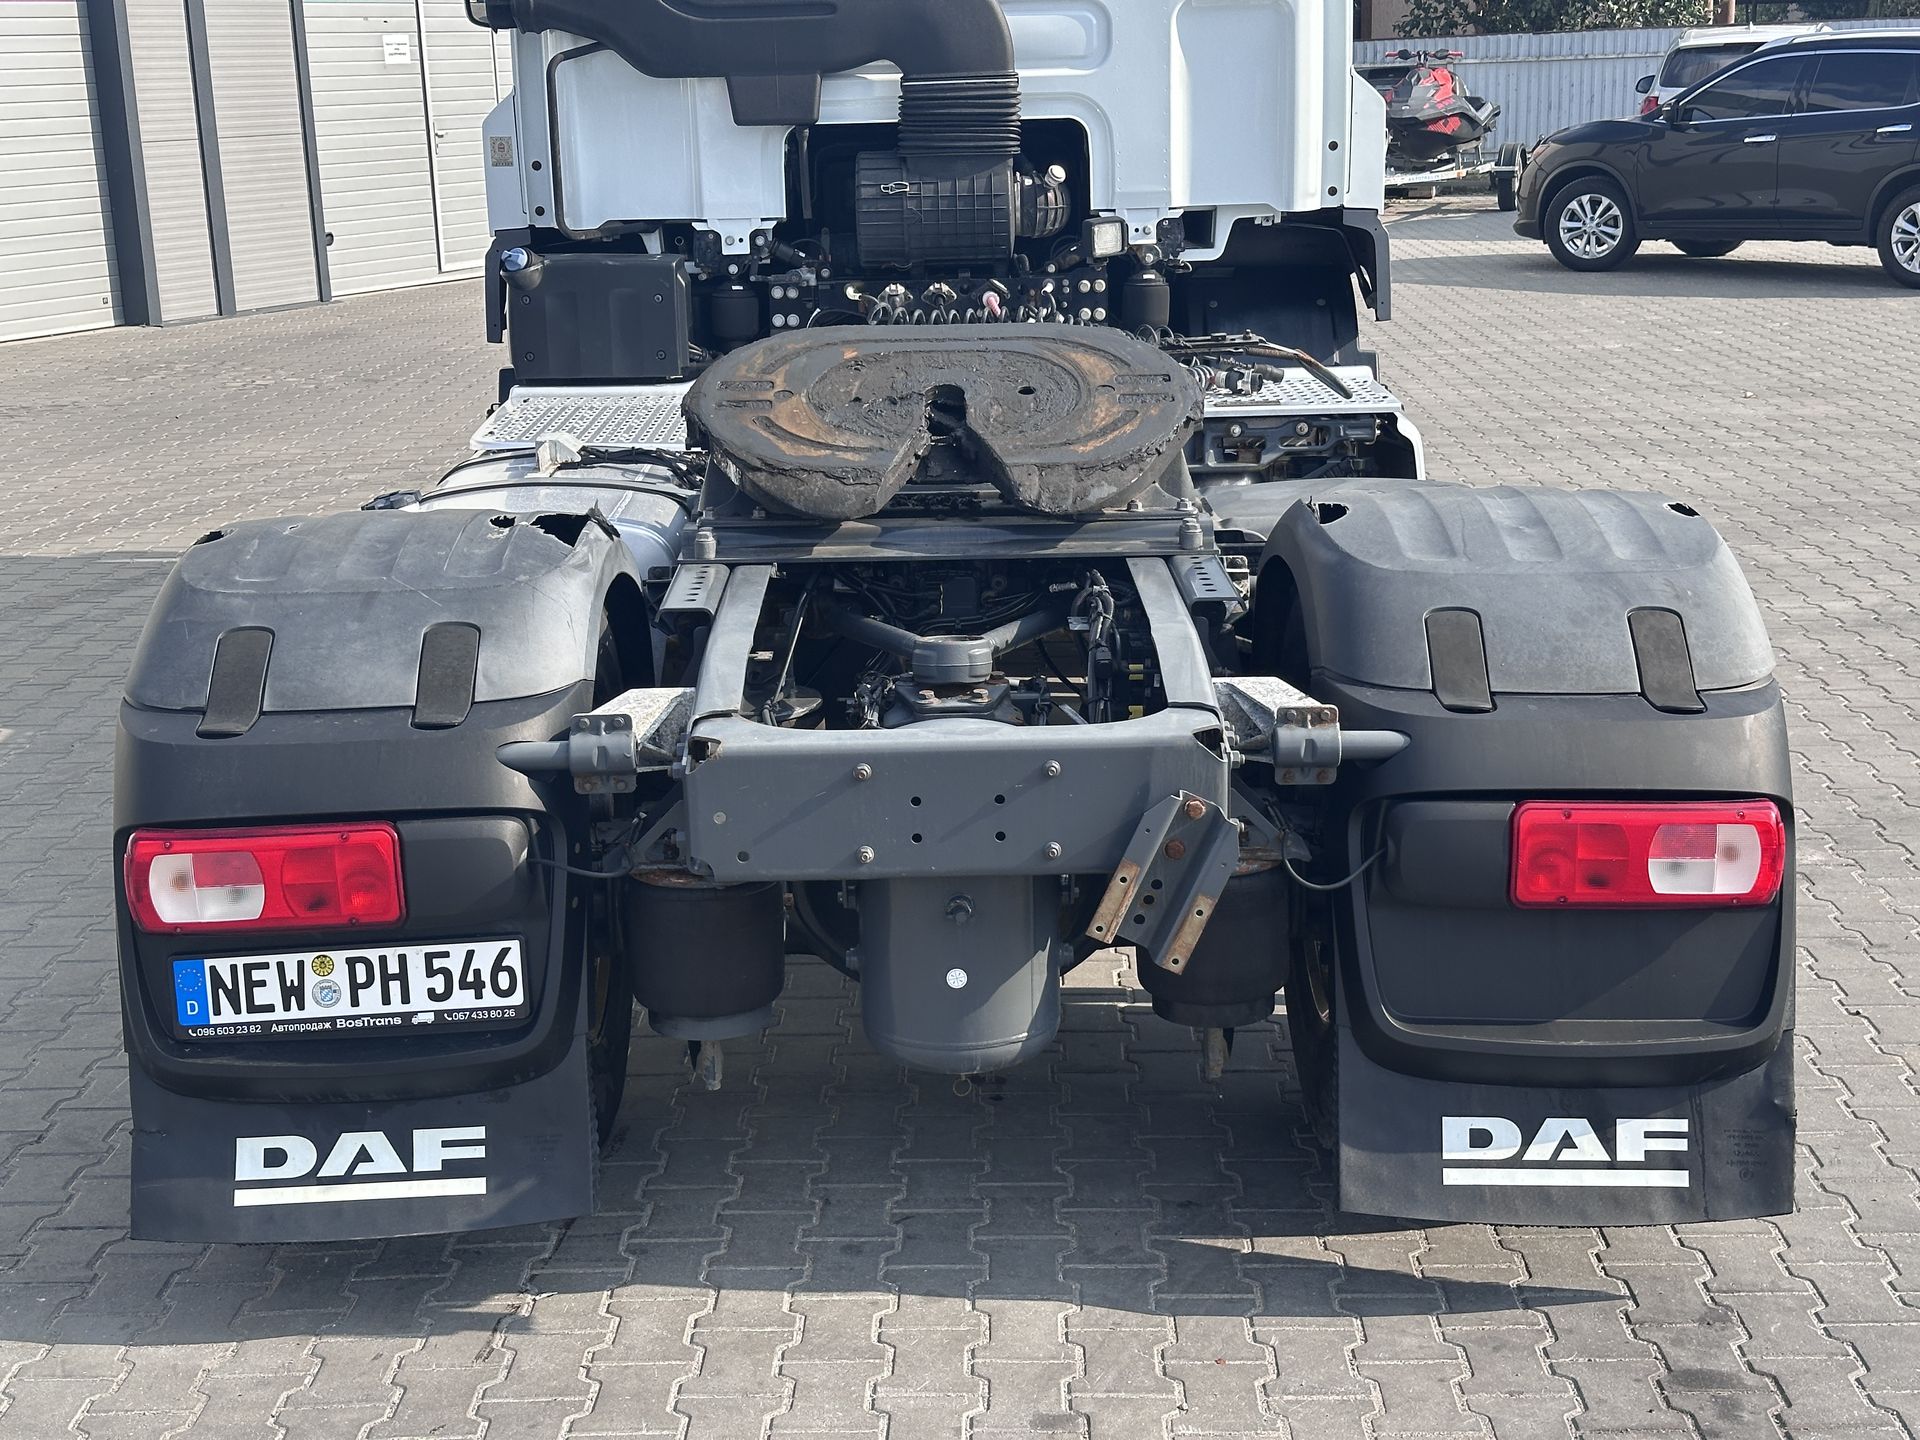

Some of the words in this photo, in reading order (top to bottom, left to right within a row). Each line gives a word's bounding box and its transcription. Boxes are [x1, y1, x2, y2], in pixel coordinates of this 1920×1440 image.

[209, 959, 305, 1016] NEW
[345, 955, 411, 1008] PH
[424, 946, 518, 1003] 546
[186, 1000, 199, 1016] D
[452, 1011, 470, 1021] 067
[471, 1010, 489, 1020] 433
[490, 1009, 502, 1019] 80
[503, 1008, 516, 1018] 26
[270, 1021, 332, 1033] Автопродаж
[336, 1016, 402, 1029] BosTrans
[197, 1027, 216, 1037] 096
[216, 1026, 235, 1036] 603
[236, 1025, 248, 1035] 23
[249, 1024, 262, 1034] 82
[1441, 1116, 1689, 1162] DAF
[234, 1125, 486, 1182] DAF
